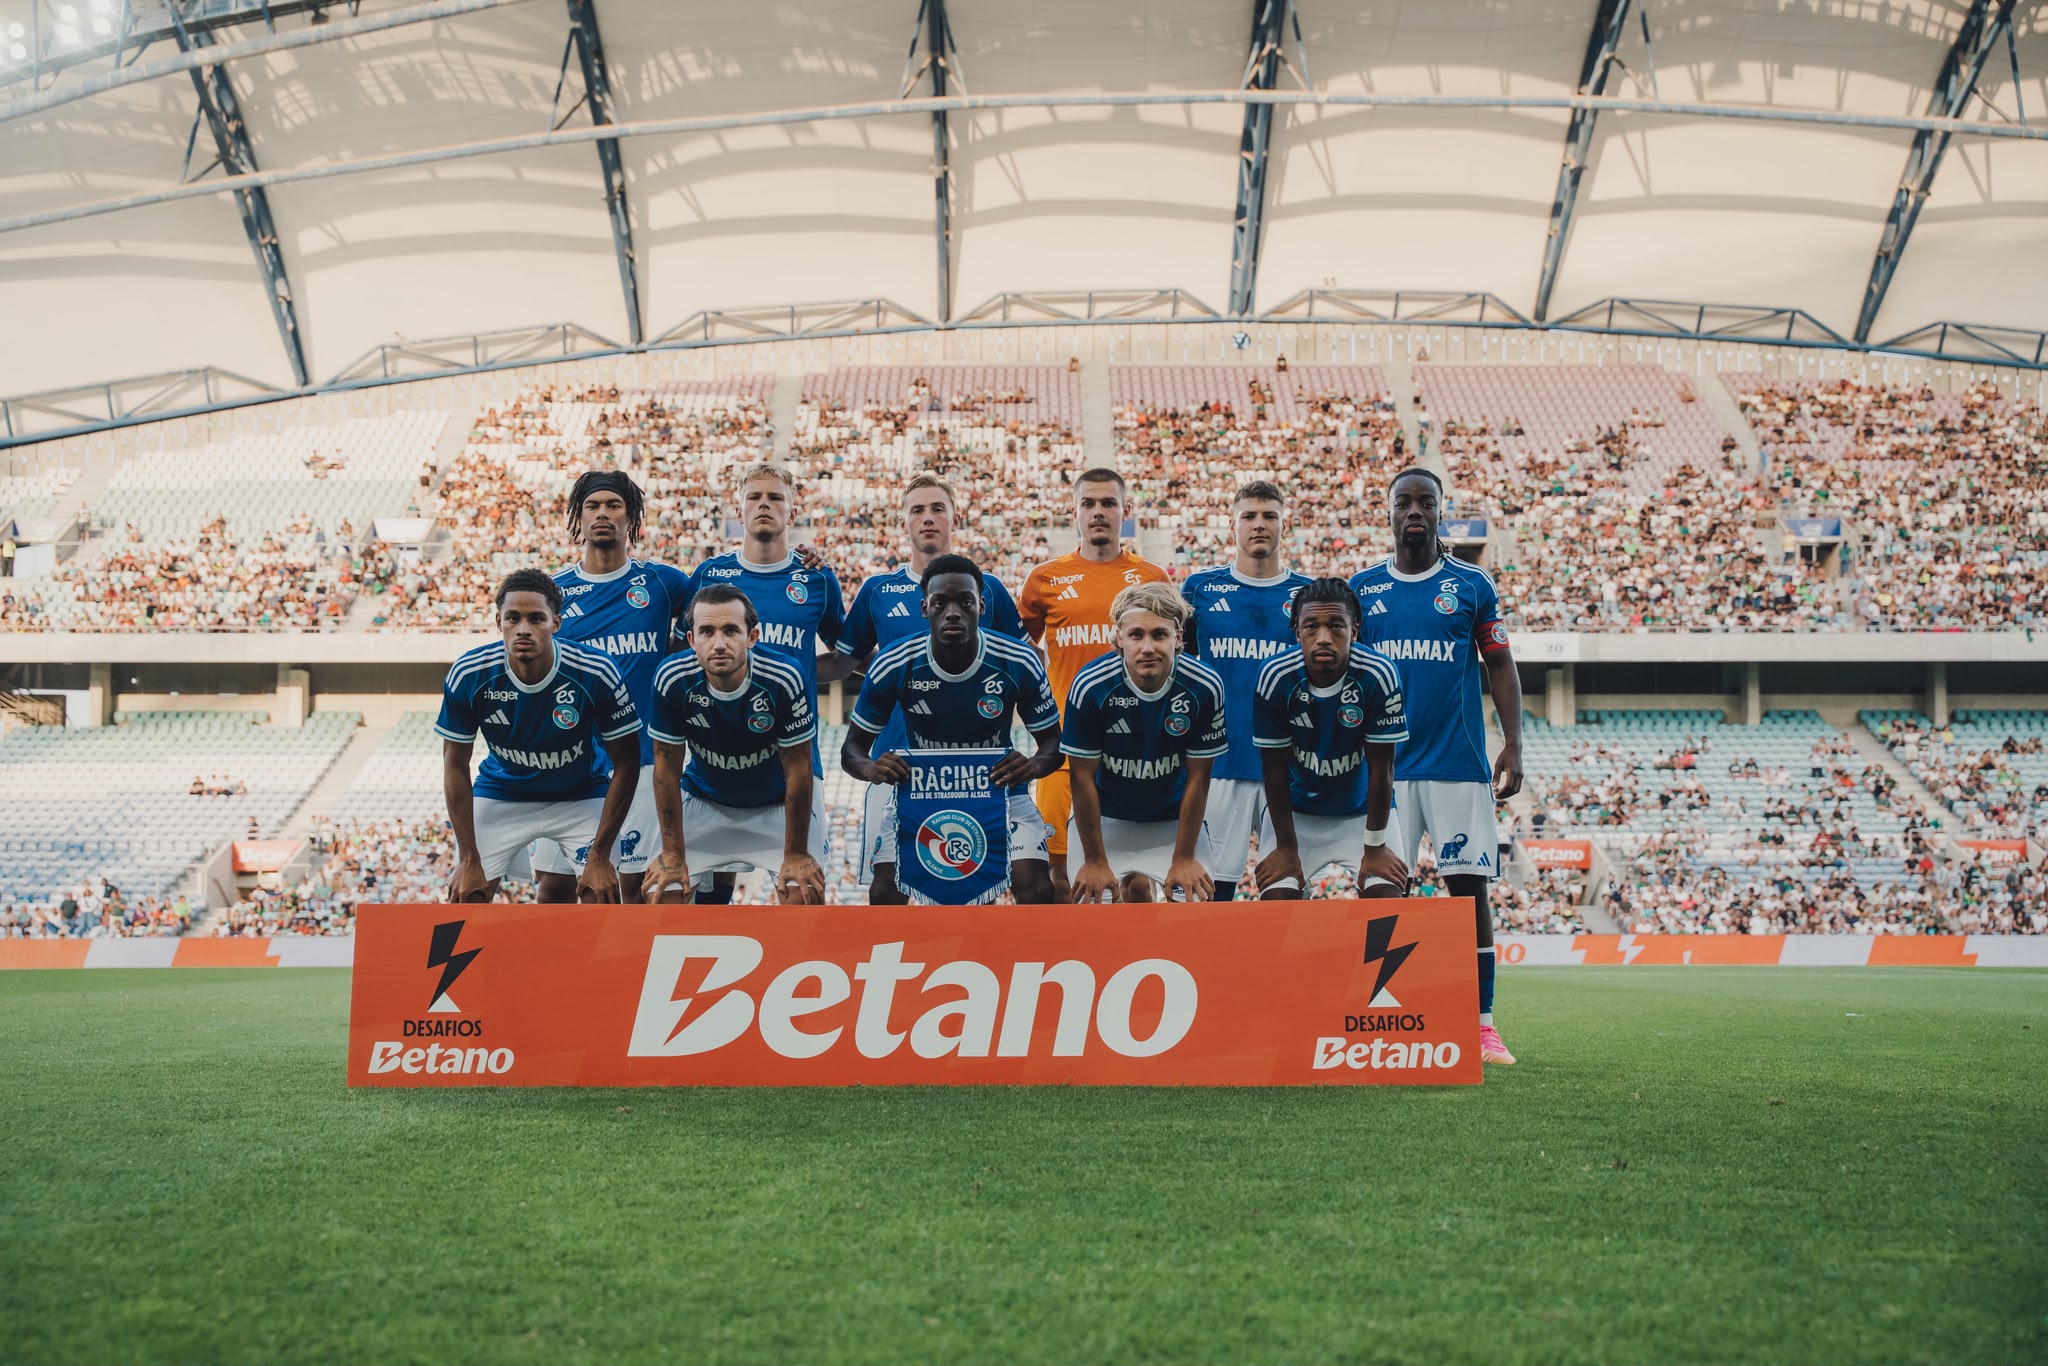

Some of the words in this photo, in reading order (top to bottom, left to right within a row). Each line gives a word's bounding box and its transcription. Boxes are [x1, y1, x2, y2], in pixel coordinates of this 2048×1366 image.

[757, 623, 806, 649] AMAX
[1056, 624, 1118, 648] WINAM
[911, 765, 990, 791] RACING
[910, 792, 924, 800] CLUB
[925, 792, 933, 800] DE
[970, 790, 991, 798] ALSACE
[627, 934, 1199, 1060] Betano
[403, 1020, 482, 1037] DESAFIOS
[1345, 1014, 1425, 1032] DESAFIOS
[367, 1041, 515, 1075] Betano
[1312, 1036, 1461, 1070] Betano
